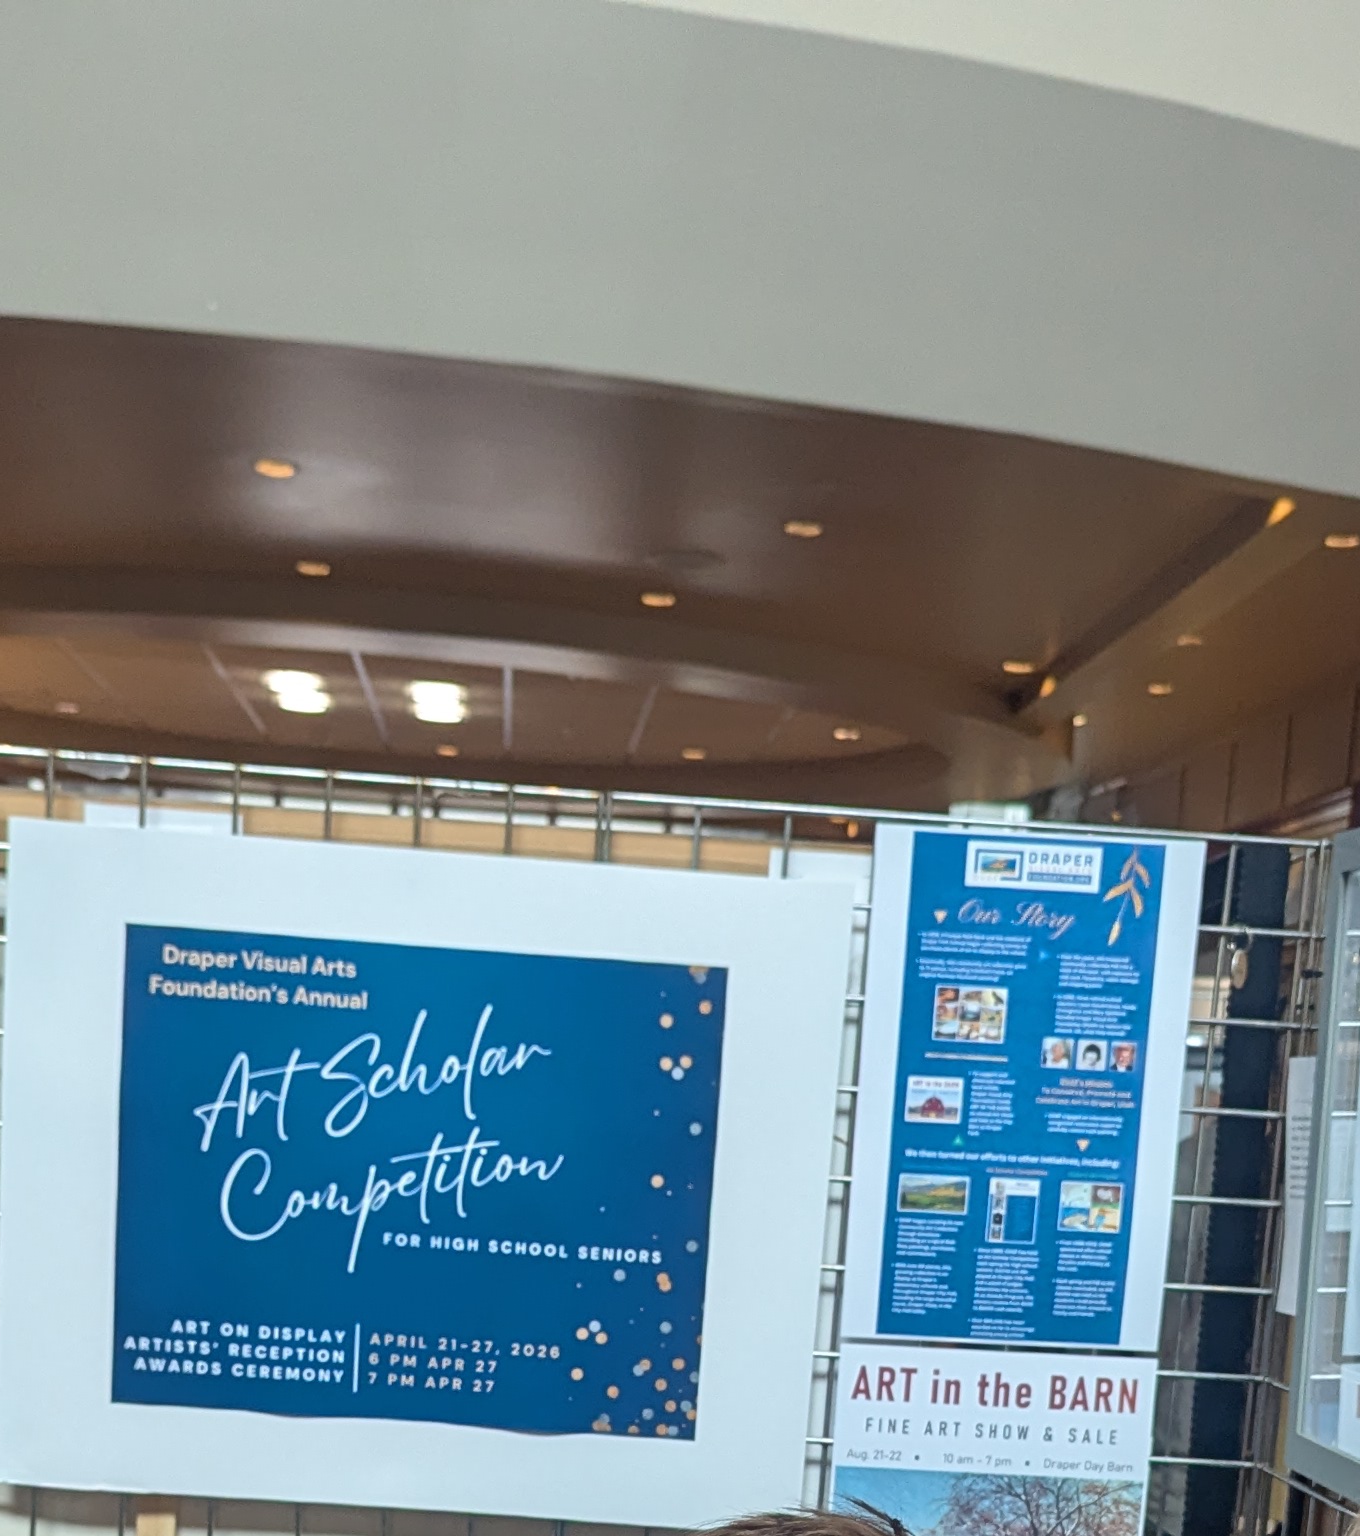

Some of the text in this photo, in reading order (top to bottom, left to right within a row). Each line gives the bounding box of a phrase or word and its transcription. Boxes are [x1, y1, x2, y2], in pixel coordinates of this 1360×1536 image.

[1028, 852, 1094, 867] DRAPER
[957, 898, 1075, 940] Our Story
[162, 943, 357, 978] Draper Visual Arts
[148, 974, 368, 1010] Foundation's Annual
[193, 1003, 552, 1152] Art Scholar
[220, 1126, 564, 1274] Competition
[382, 1232, 662, 1265] FOR HIGH SCHOOL SENIORS
[171, 1319, 346, 1344] ART ON DISPLAY
[123, 1336, 345, 1364] ARTISTS' RECEPTION
[369, 1332, 560, 1359] APRIL 21-27, 2026
[133, 1356, 344, 1383] AWARDS CEREMONY
[368, 1352, 498, 1374] 6 PM APR 27
[368, 1371, 495, 1393] 7 PM APR 27
[850, 1364, 1139, 1414] ART in the BARN
[865, 1417, 1118, 1445] FINE ART SHOW & SALE
[846, 1448, 902, 1462] Aug. 21-22
[943, 1453, 954, 1464] 10
[956, 1455, 974, 1465] am
[985, 1455, 992, 1466] 7
[994, 1457, 1012, 1469] pm
[1043, 1457, 1132, 1473] Draper Day Barn
